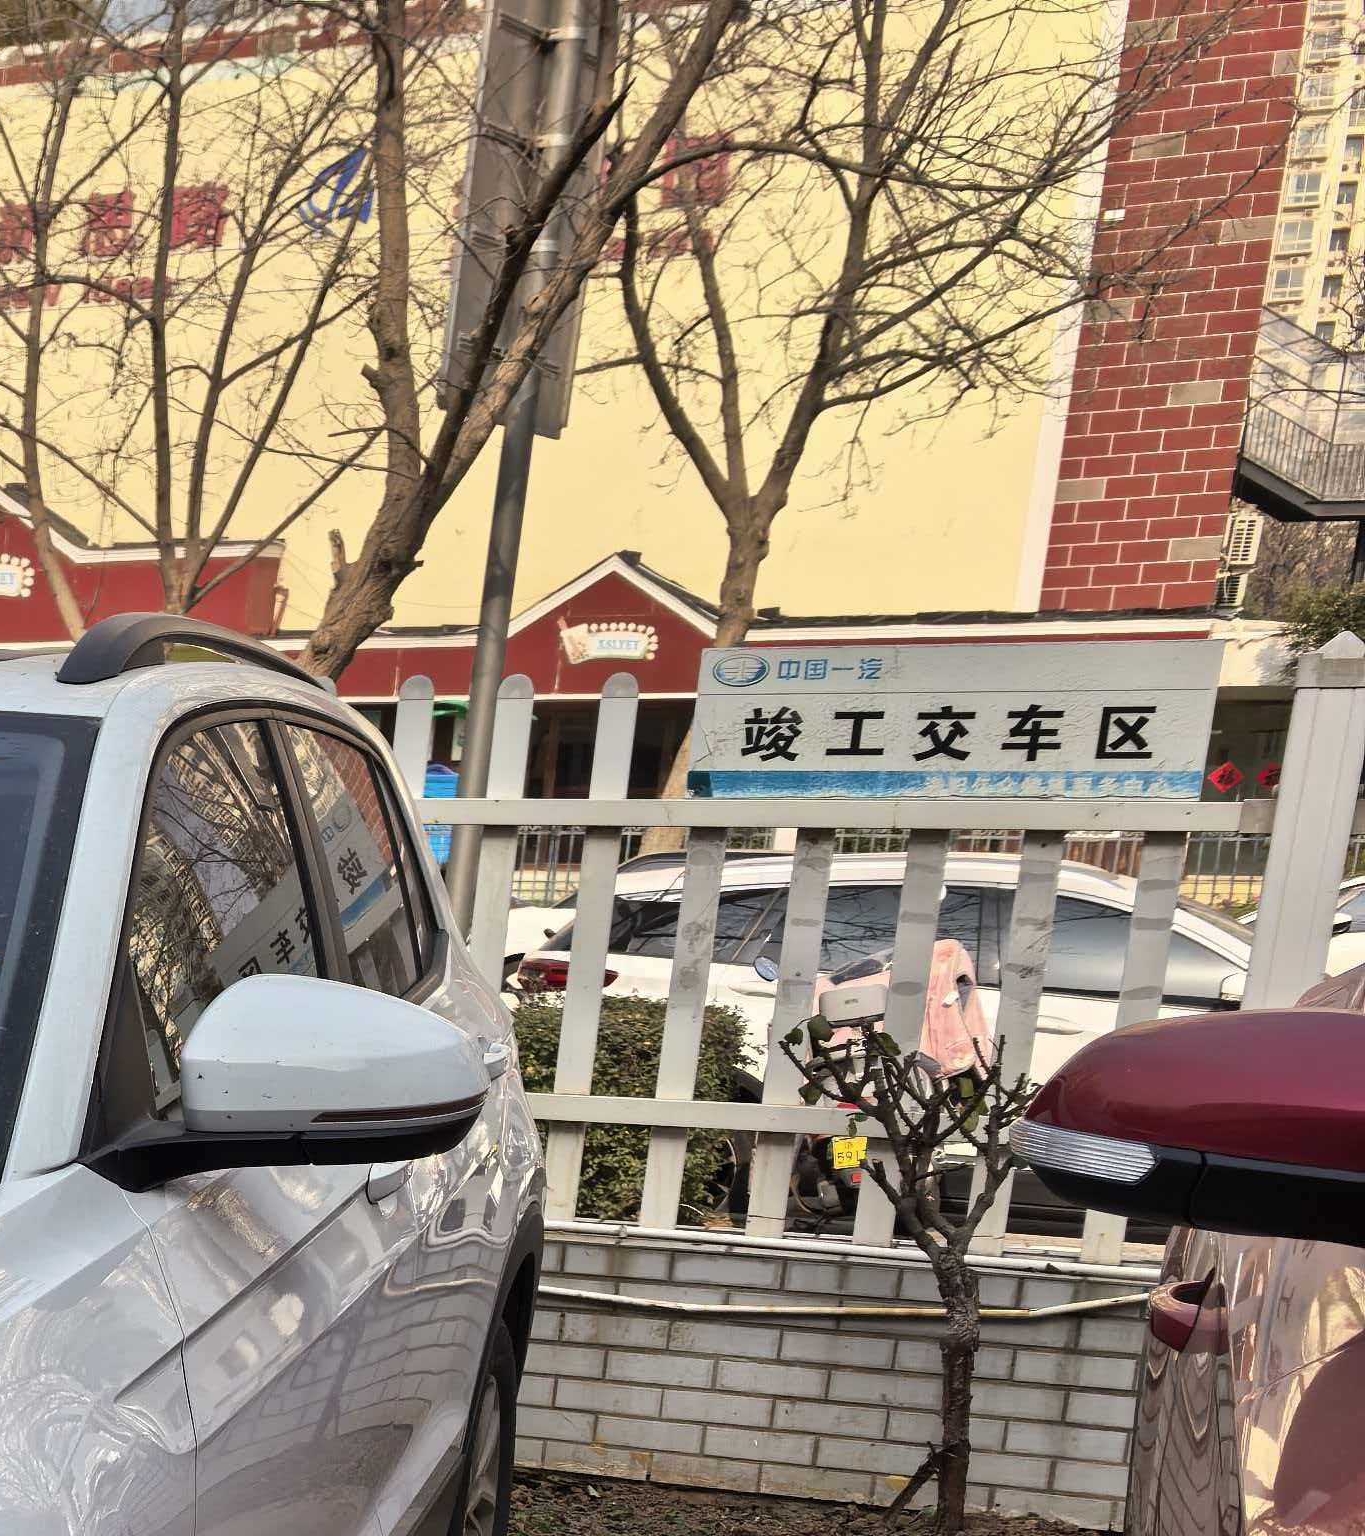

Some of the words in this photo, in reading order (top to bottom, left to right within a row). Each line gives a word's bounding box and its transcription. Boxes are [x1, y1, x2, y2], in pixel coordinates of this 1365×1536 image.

[777, 658, 884, 681] 中国一汽
[740, 703, 1158, 763] 竣工交车区
